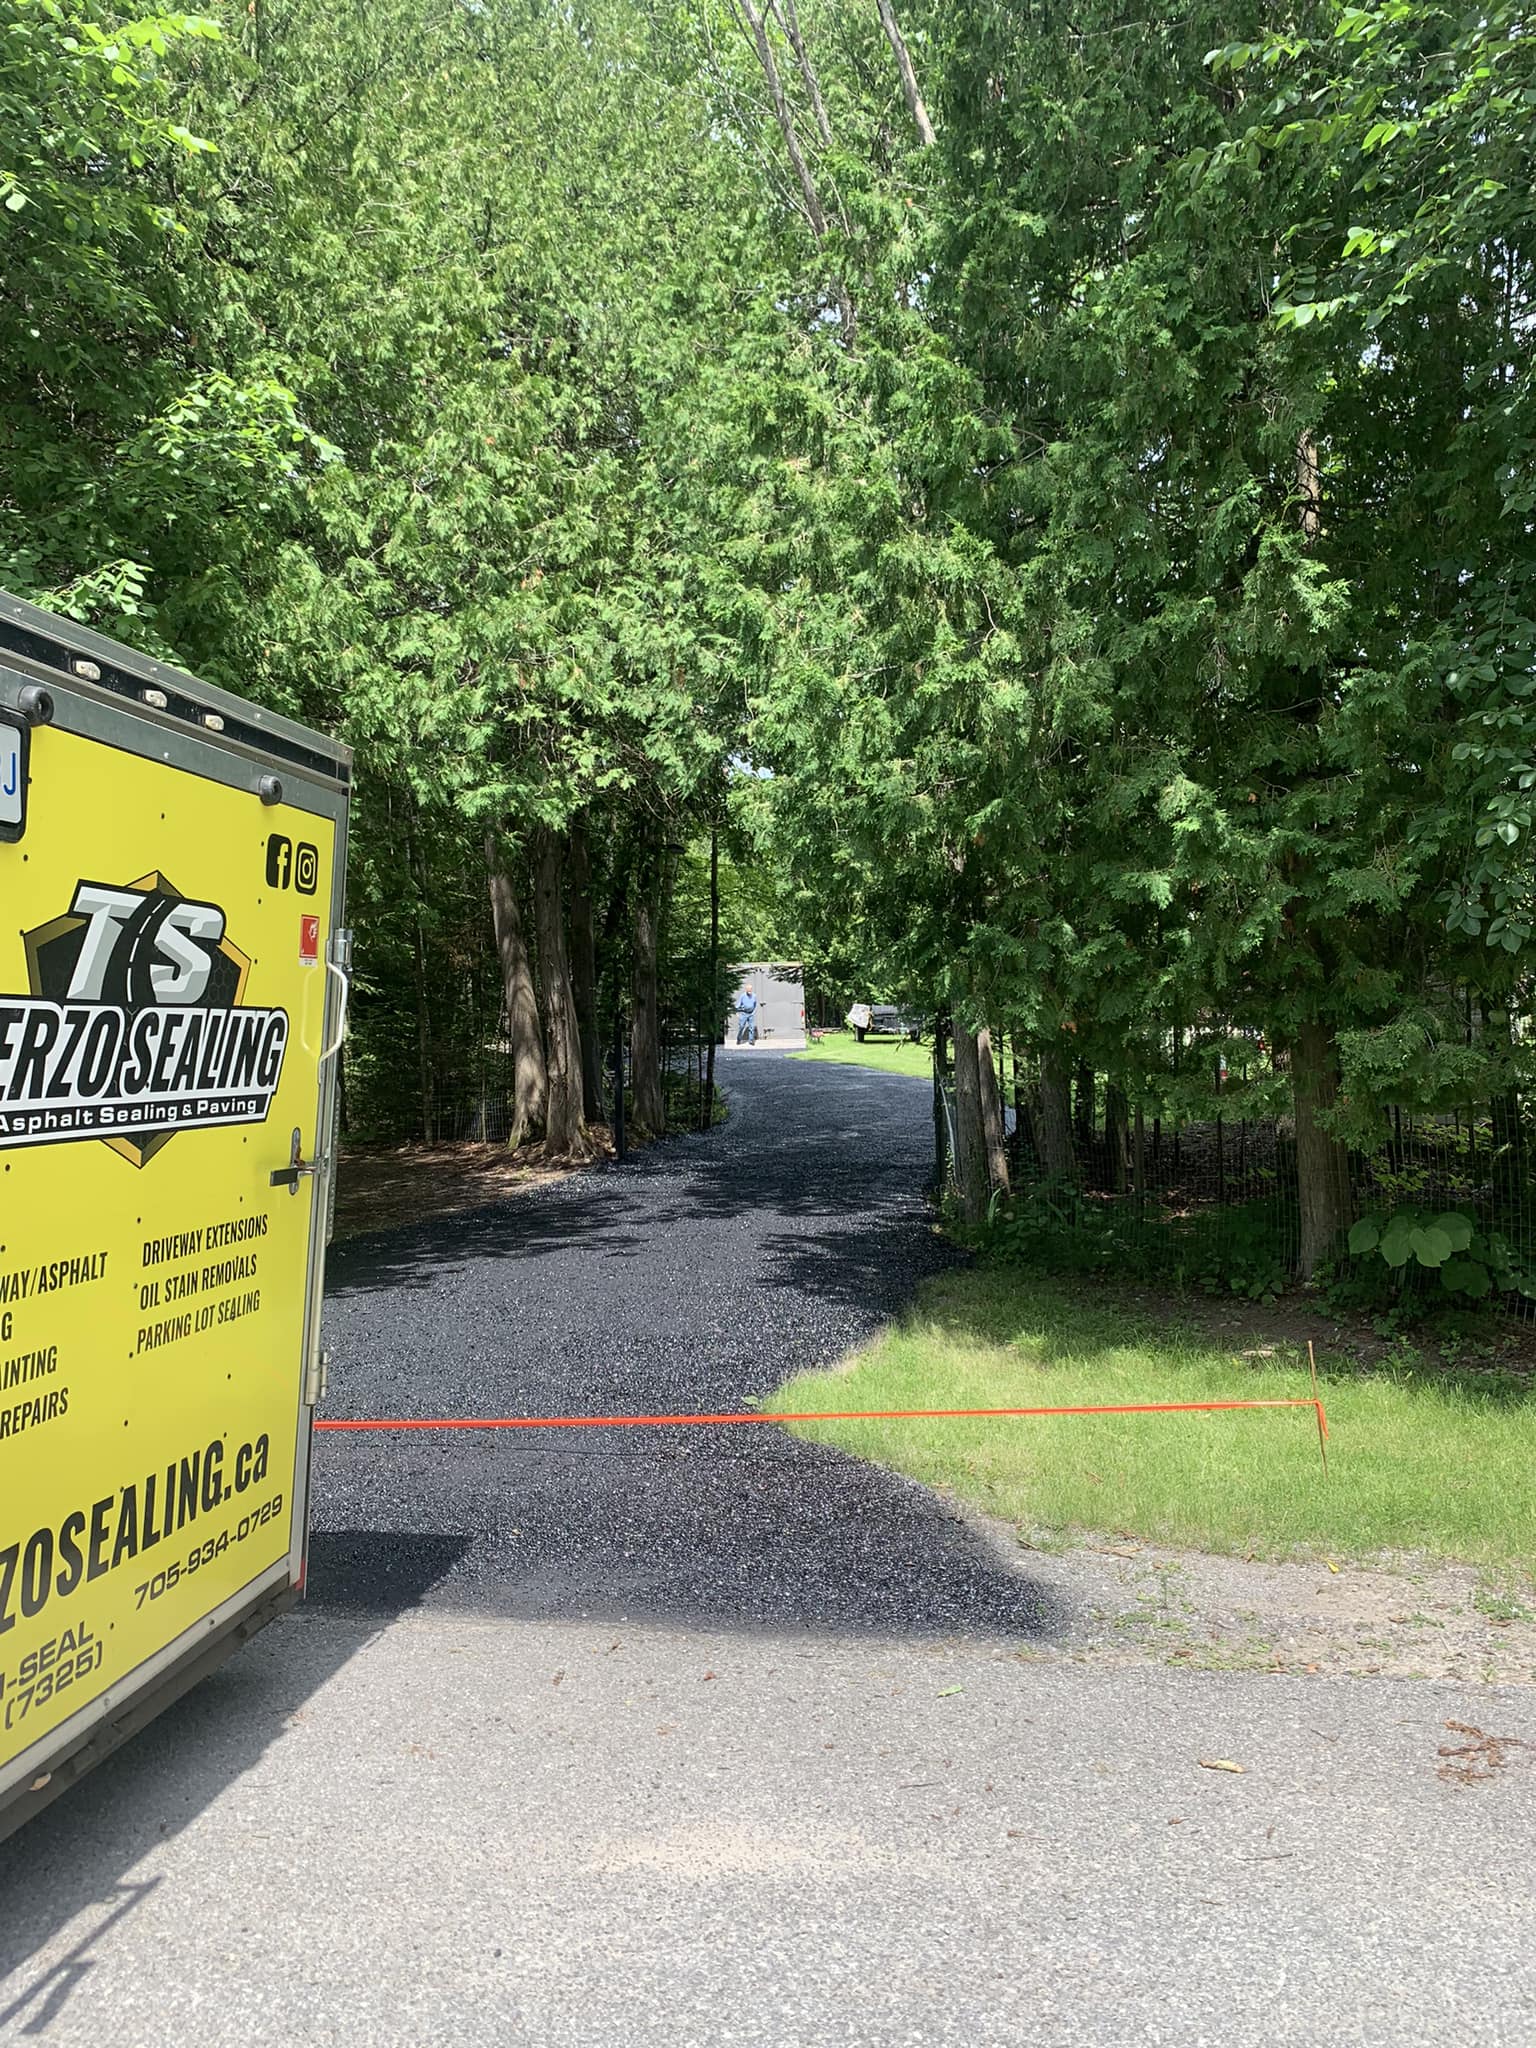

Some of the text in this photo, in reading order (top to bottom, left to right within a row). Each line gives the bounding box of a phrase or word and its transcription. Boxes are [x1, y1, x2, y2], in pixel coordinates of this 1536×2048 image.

[124, 1011, 286, 1096] SEALING
[0, 1098, 257, 1134] Asphalt Sealing & Paving
[142, 1214, 268, 1267] DRIVEWAY EXTENSIONS
[140, 1254, 257, 1311] OIL STAIN REMOVALS
[1, 1311, 13, 1341] G
[137, 1290, 260, 1355] PARKING LOT SEALING
[0, 1387, 69, 1440] REPAIRS
[0, 1433, 269, 1635] ZOSEALING.ca
[134, 1494, 283, 1611] 705-934-0729
